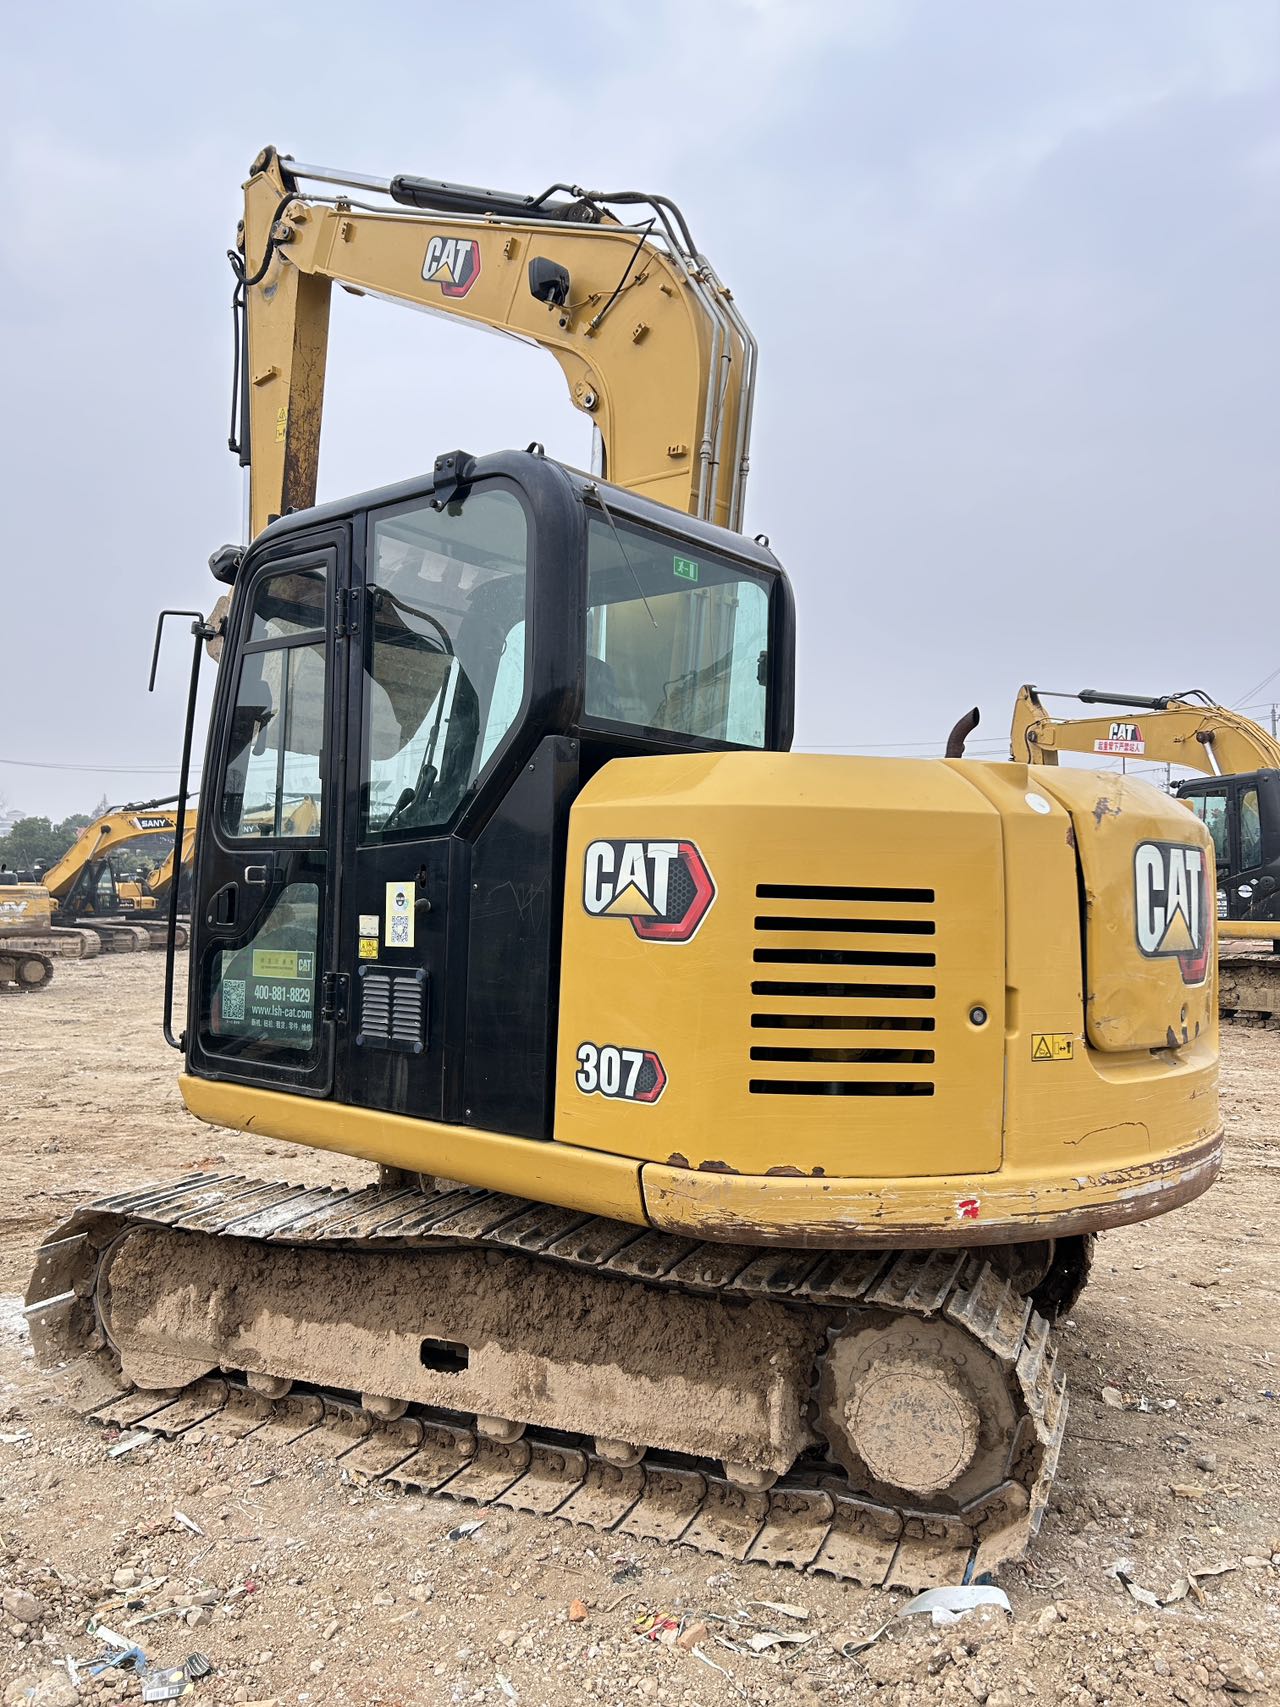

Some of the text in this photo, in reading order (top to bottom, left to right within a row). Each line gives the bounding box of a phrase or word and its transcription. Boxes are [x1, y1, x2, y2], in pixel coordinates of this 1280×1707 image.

[422, 237, 472, 283] CAT
[1108, 722, 1135, 741] CAT
[141, 819, 166, 828] SANY
[584, 841, 679, 916] CAT
[1135, 844, 1202, 952] CAT
[298, 958, 311, 972] CAT
[254, 985, 310, 1003] 400-881-8829
[251, 1005, 312, 1019] www.lsh-cat.com
[577, 1044, 644, 1097] 307
